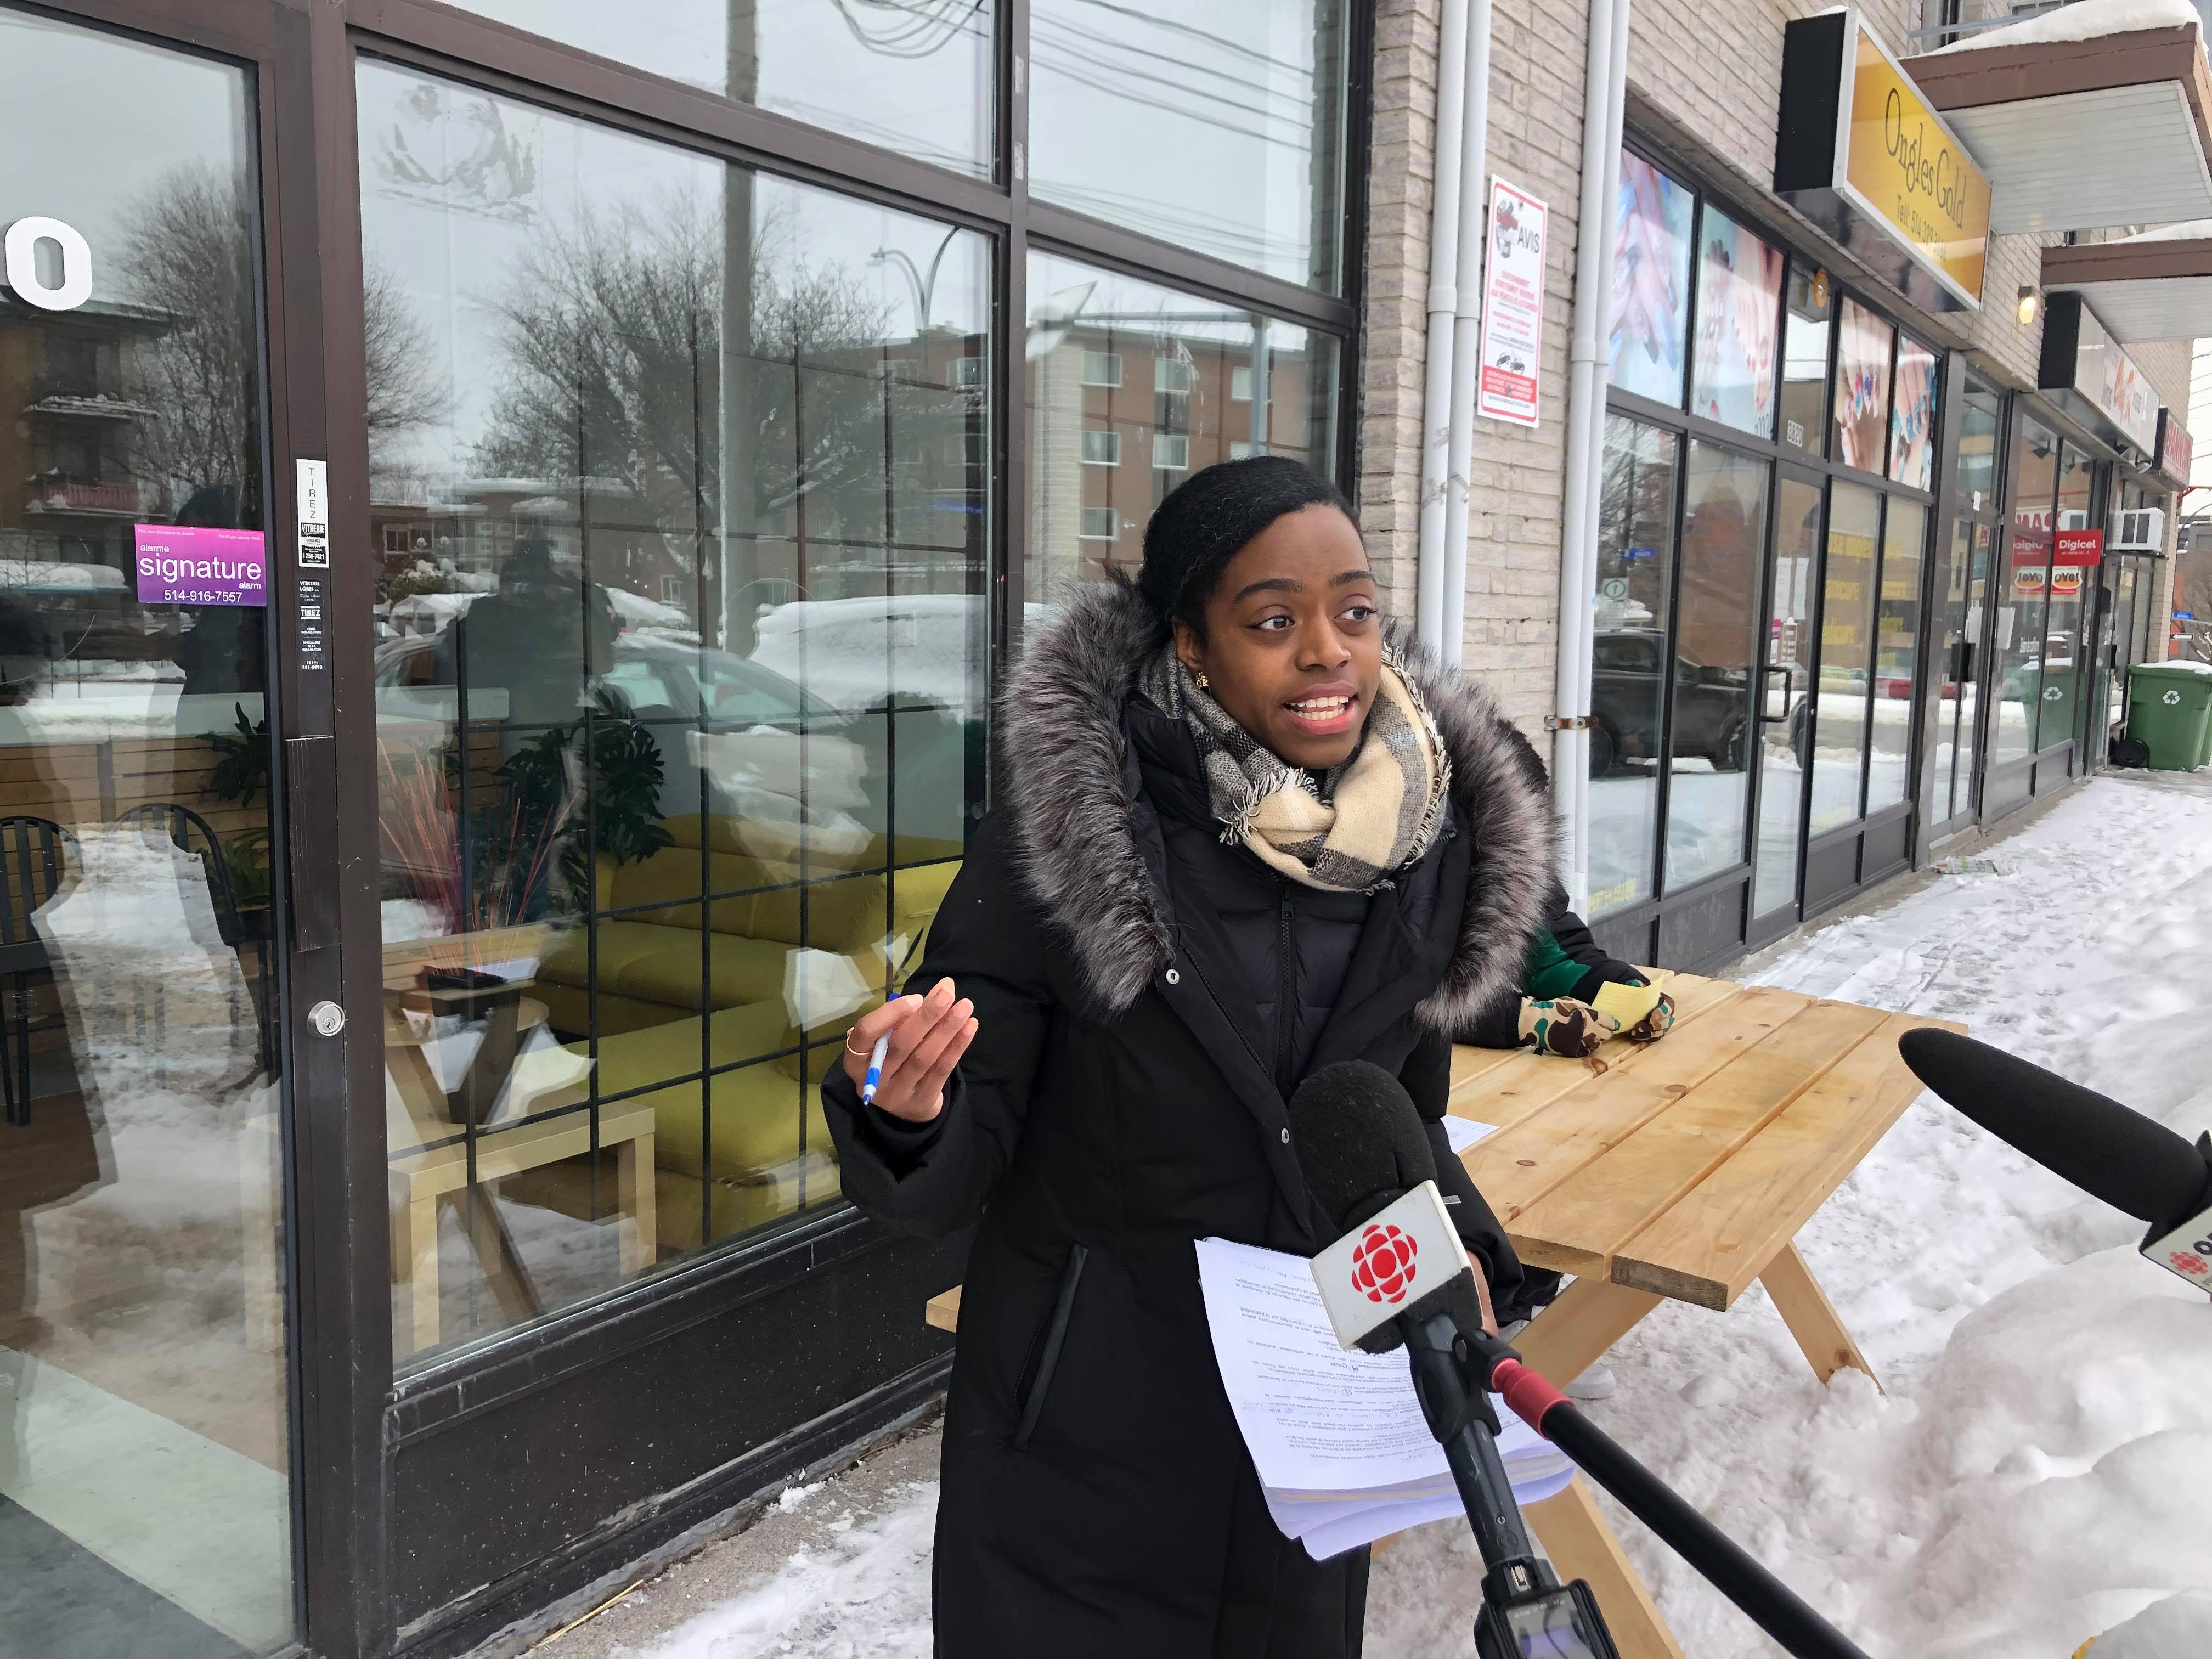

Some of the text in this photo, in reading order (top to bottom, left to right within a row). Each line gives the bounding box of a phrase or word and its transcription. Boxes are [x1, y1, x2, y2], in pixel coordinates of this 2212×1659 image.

[1886, 88, 1966, 229] Ongles Gold
[1517, 226, 1539, 253] AVIS
[302, 524, 325, 534] VITRERIE
[140, 543, 170, 553] alarme
[2059, 539, 2096, 551] Digicel
[140, 552, 262, 583] signature
[239, 580, 261, 589] alarm
[164, 589, 243, 602] 514-916-7557
